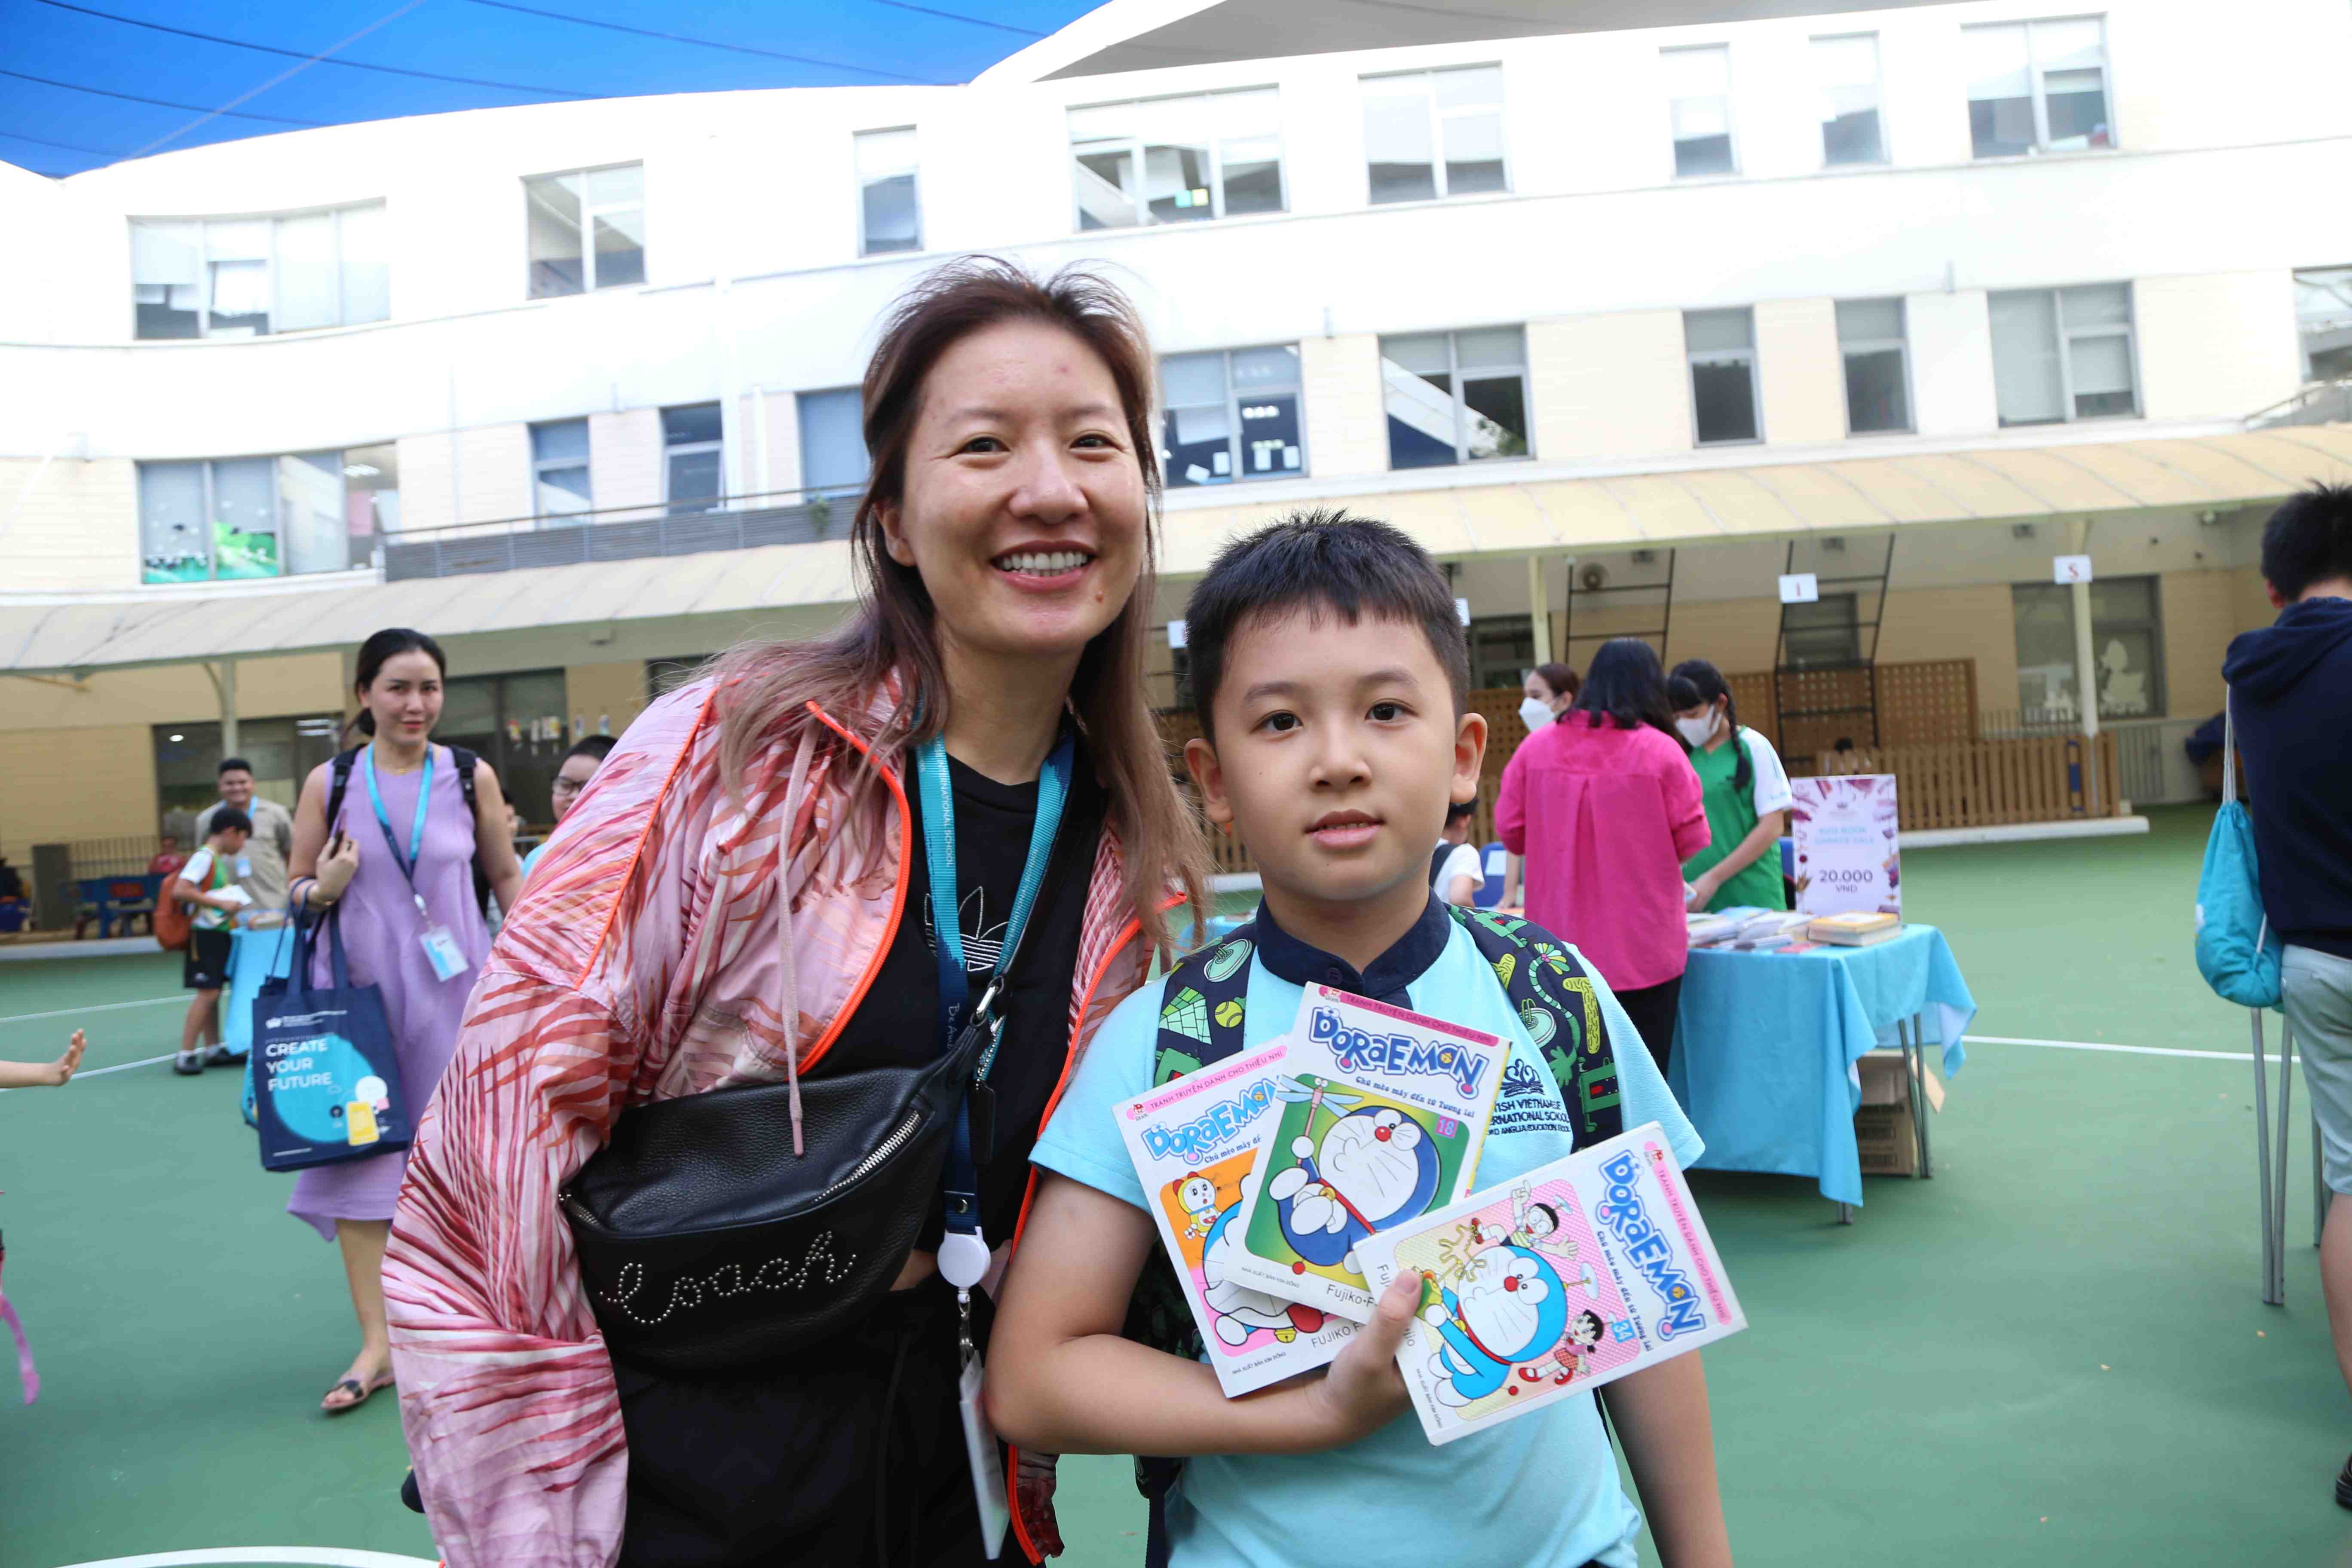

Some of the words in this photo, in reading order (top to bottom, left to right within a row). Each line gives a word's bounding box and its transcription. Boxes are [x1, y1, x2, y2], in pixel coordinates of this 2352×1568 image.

[937, 760, 951, 827] INTERNATIONAL
[1819, 869, 1873, 883] 20.000
[1836, 884, 1858, 893] VND
[1347, 995, 1372, 1008] TRANH
[1432, 1020, 1450, 1031] CHO
[266, 1038, 328, 1057] CREATE
[266, 1057, 313, 1074] YOUR
[268, 1072, 333, 1092] FUTURE
[1150, 1096, 1174, 1109] TRANH
[1228, 1066, 1245, 1078] CHO
[1268, 1051, 1283, 1061] NHI
[1439, 1118, 1455, 1135] 18
[1204, 1152, 1219, 1164] Chú
[1220, 1148, 1235, 1160] mèo
[1236, 1140, 1251, 1152] máy
[1659, 1169, 1673, 1197] TRANH
[1696, 1258, 1708, 1277] CHO
[1716, 1302, 1727, 1319] NHI
[1311, 1326, 1351, 1348] FUJIKO
[1615, 1321, 1633, 1340] 34
